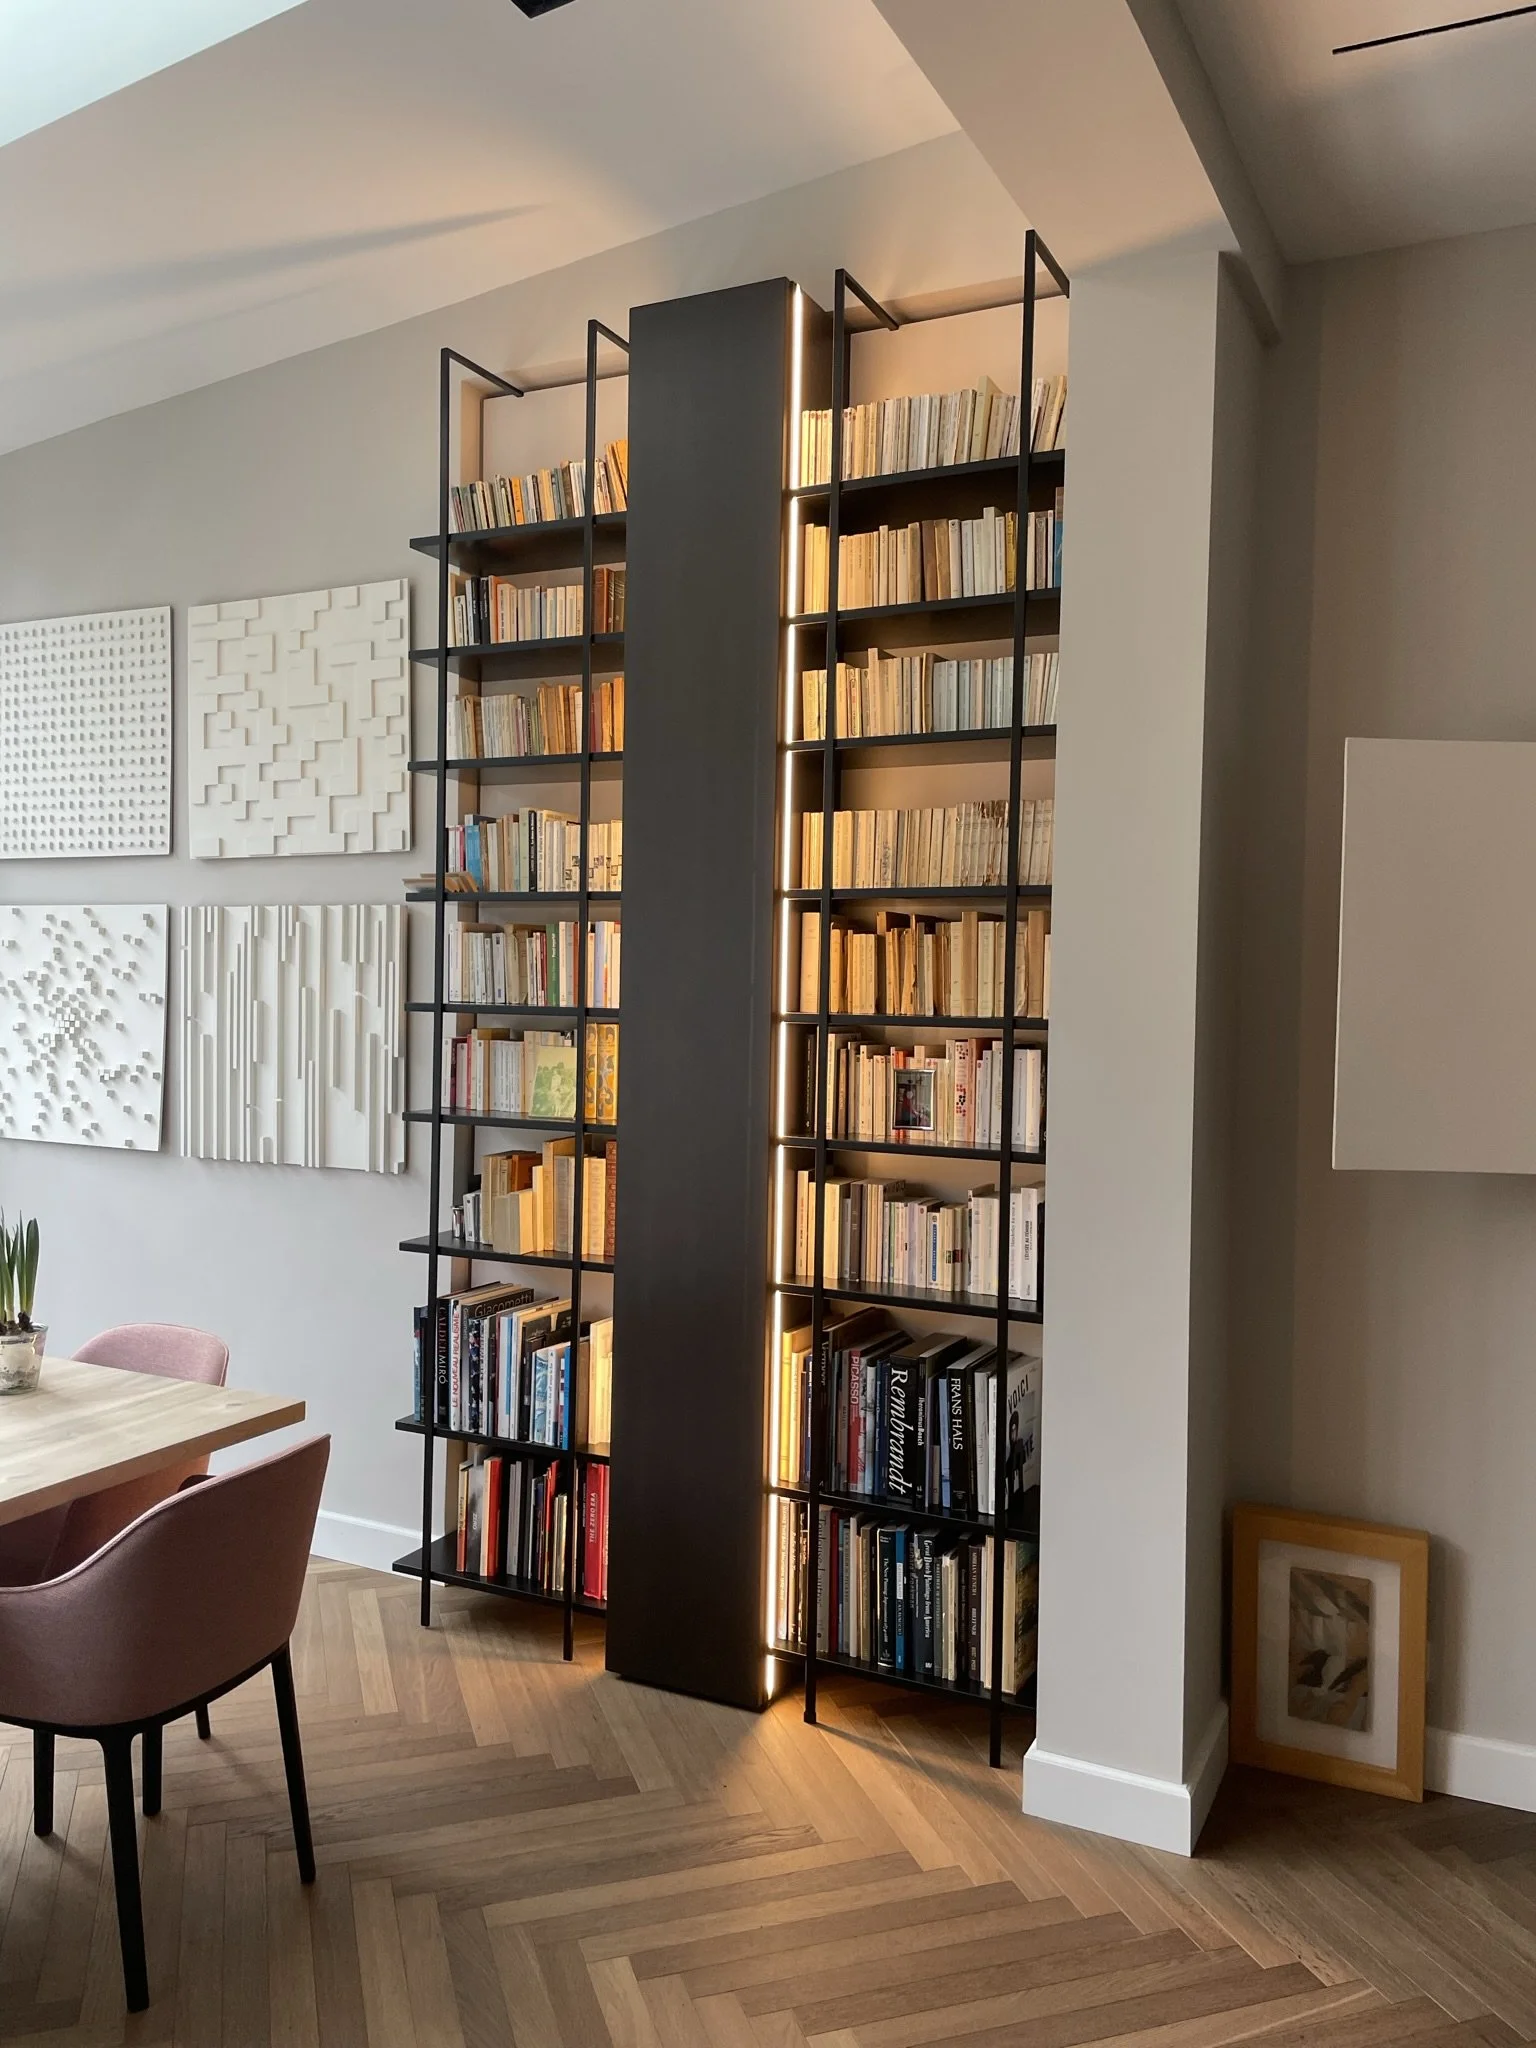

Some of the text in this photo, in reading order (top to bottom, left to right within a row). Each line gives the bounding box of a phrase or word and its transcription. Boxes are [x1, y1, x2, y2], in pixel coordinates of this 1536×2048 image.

[474, 1293, 533, 1318] Giacometti
[438, 1353, 449, 1385] MIRÓ
[451, 1357, 460, 1396] NOUVEAU
[849, 1355, 860, 1405] PICASSO
[451, 1397, 459, 1408] LE
[949, 1377, 964, 1451] FRANS HALS
[1007, 1374, 1029, 1414] VOICI
[888, 1367, 914, 1495] Rembrandt
[923, 1540, 933, 1639] Great Dutch Paintings from America
